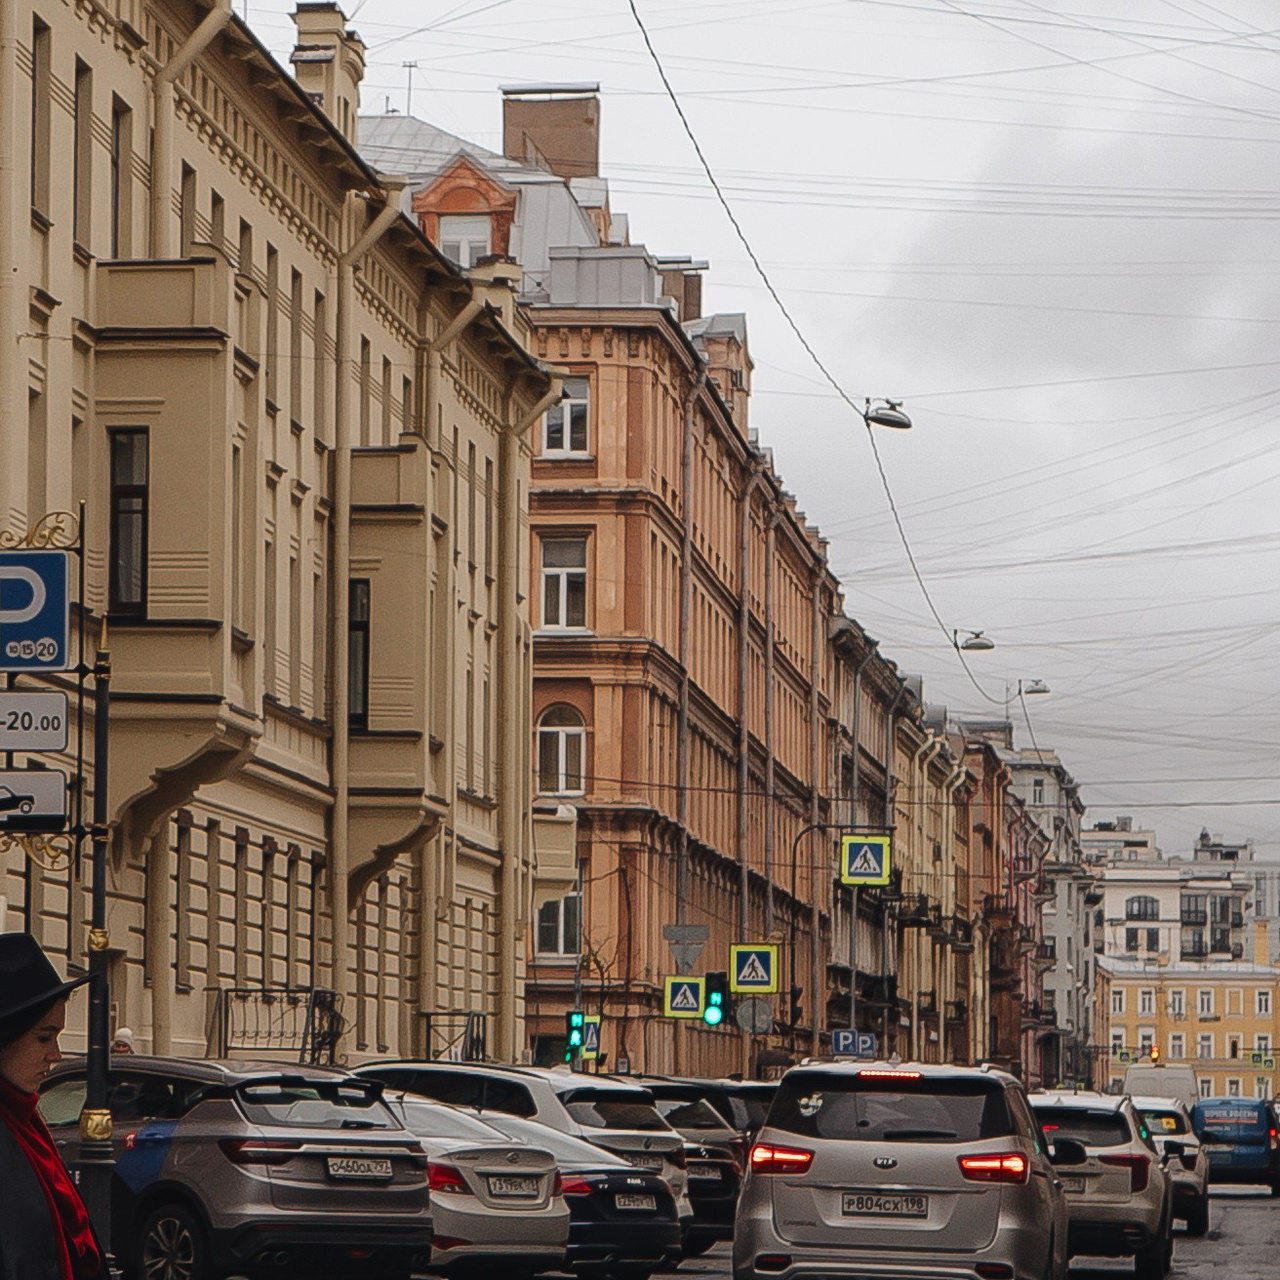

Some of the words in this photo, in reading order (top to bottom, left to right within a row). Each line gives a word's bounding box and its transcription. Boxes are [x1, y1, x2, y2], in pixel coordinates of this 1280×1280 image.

[8, 645, 19, 655] 10
[22, 643, 34, 655] 15
[37, 642, 56, 657] 20
[839, 1031, 853, 1052] P
[858, 1035, 872, 1053] P
[903, 1196, 924, 1210] 198
